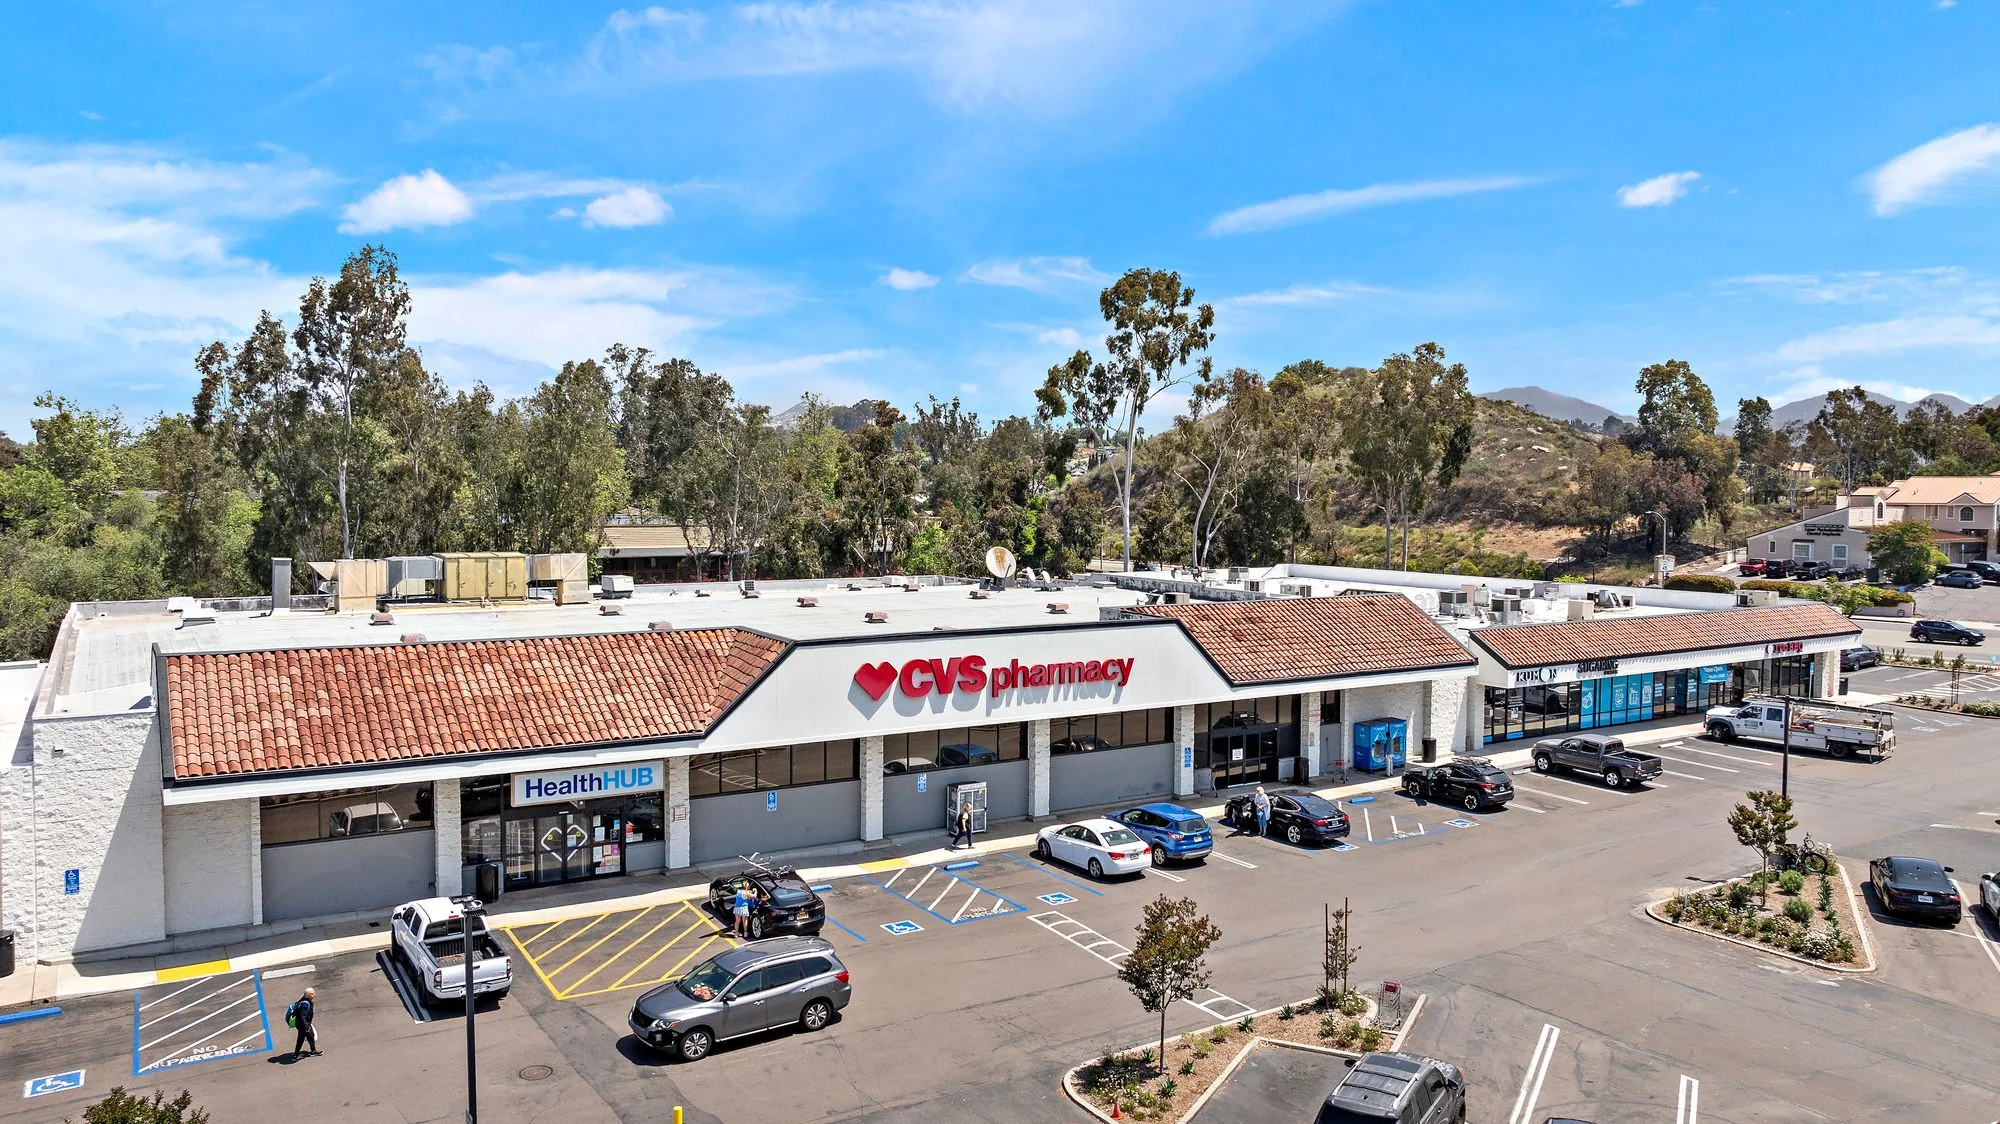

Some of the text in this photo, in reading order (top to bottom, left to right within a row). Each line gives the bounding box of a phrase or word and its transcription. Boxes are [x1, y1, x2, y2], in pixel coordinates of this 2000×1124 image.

[900, 655, 1135, 698] CVS pharmacy
[1516, 667, 1557, 683] KUMON
[525, 767, 654, 799] HealthHUB
[162, 1046, 248, 1067] PARKING
[193, 1045, 218, 1055] NO
